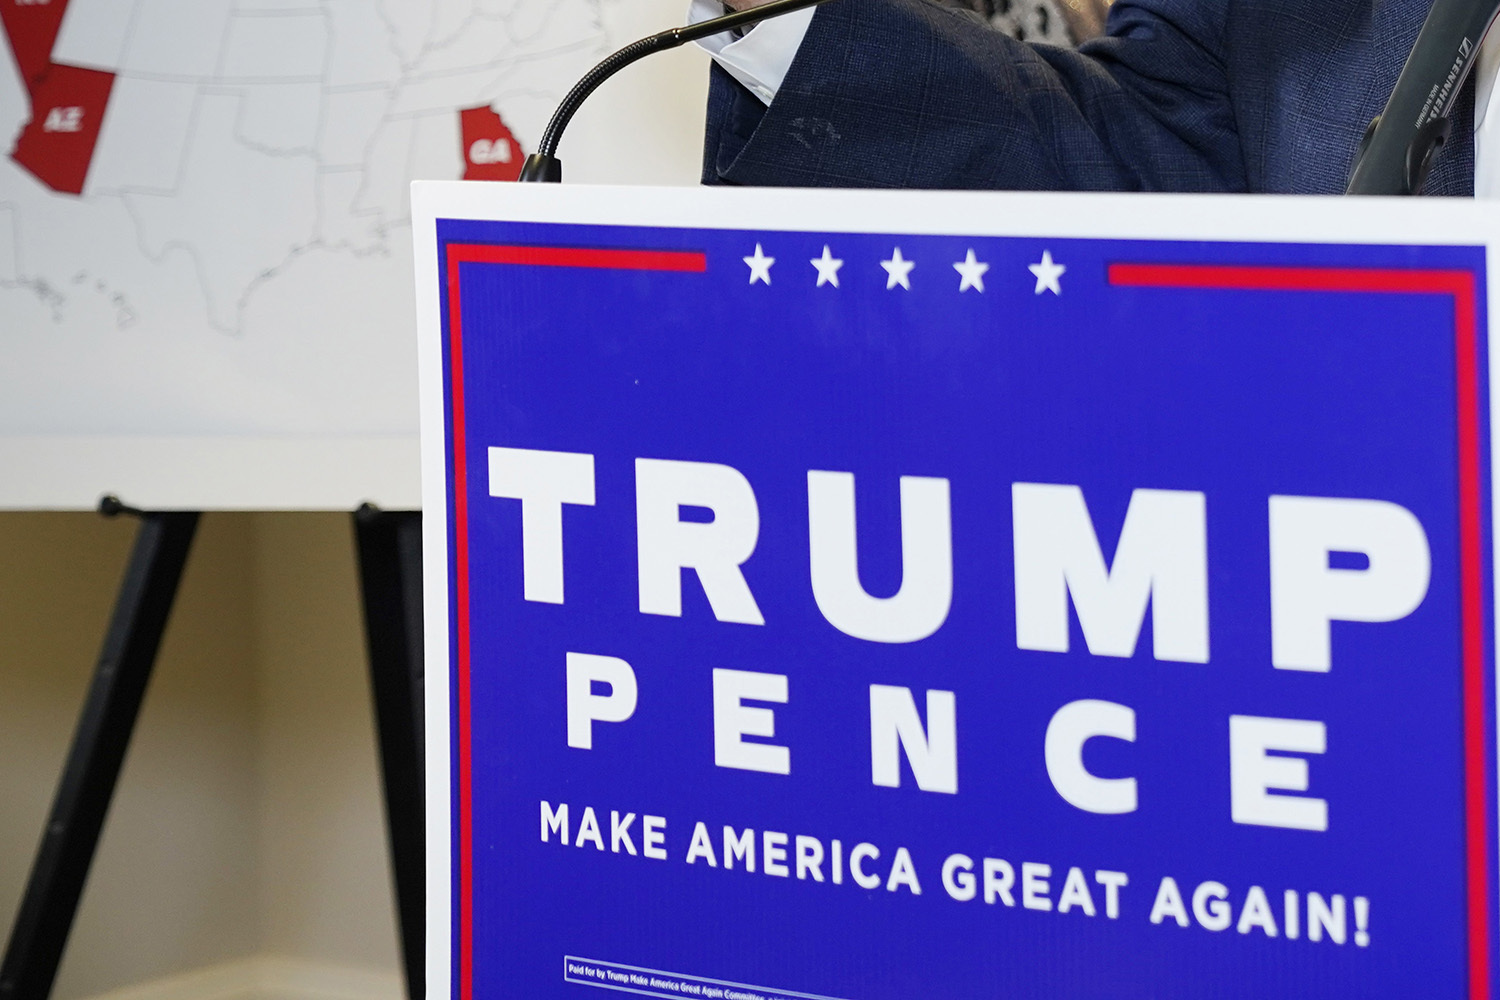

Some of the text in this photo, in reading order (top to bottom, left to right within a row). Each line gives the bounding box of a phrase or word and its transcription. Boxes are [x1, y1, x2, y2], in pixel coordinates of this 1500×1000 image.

[1426, 56, 1463, 124] SENNHEIS
[469, 138, 513, 165] GA
[488, 447, 1430, 673] TRUMP
[566, 652, 1327, 832] PENCE
[540, 801, 1370, 947] MAKE AMERICA GREAT AGAIN!
[568, 963, 585, 975] Paid
[585, 966, 596, 977] for
[596, 968, 606, 980] by
[606, 969, 630, 984] Trump
[630, 974, 649, 986] Make
[650, 977, 680, 992] America
[680, 981, 701, 995] Great
[701, 985, 724, 999] Again
